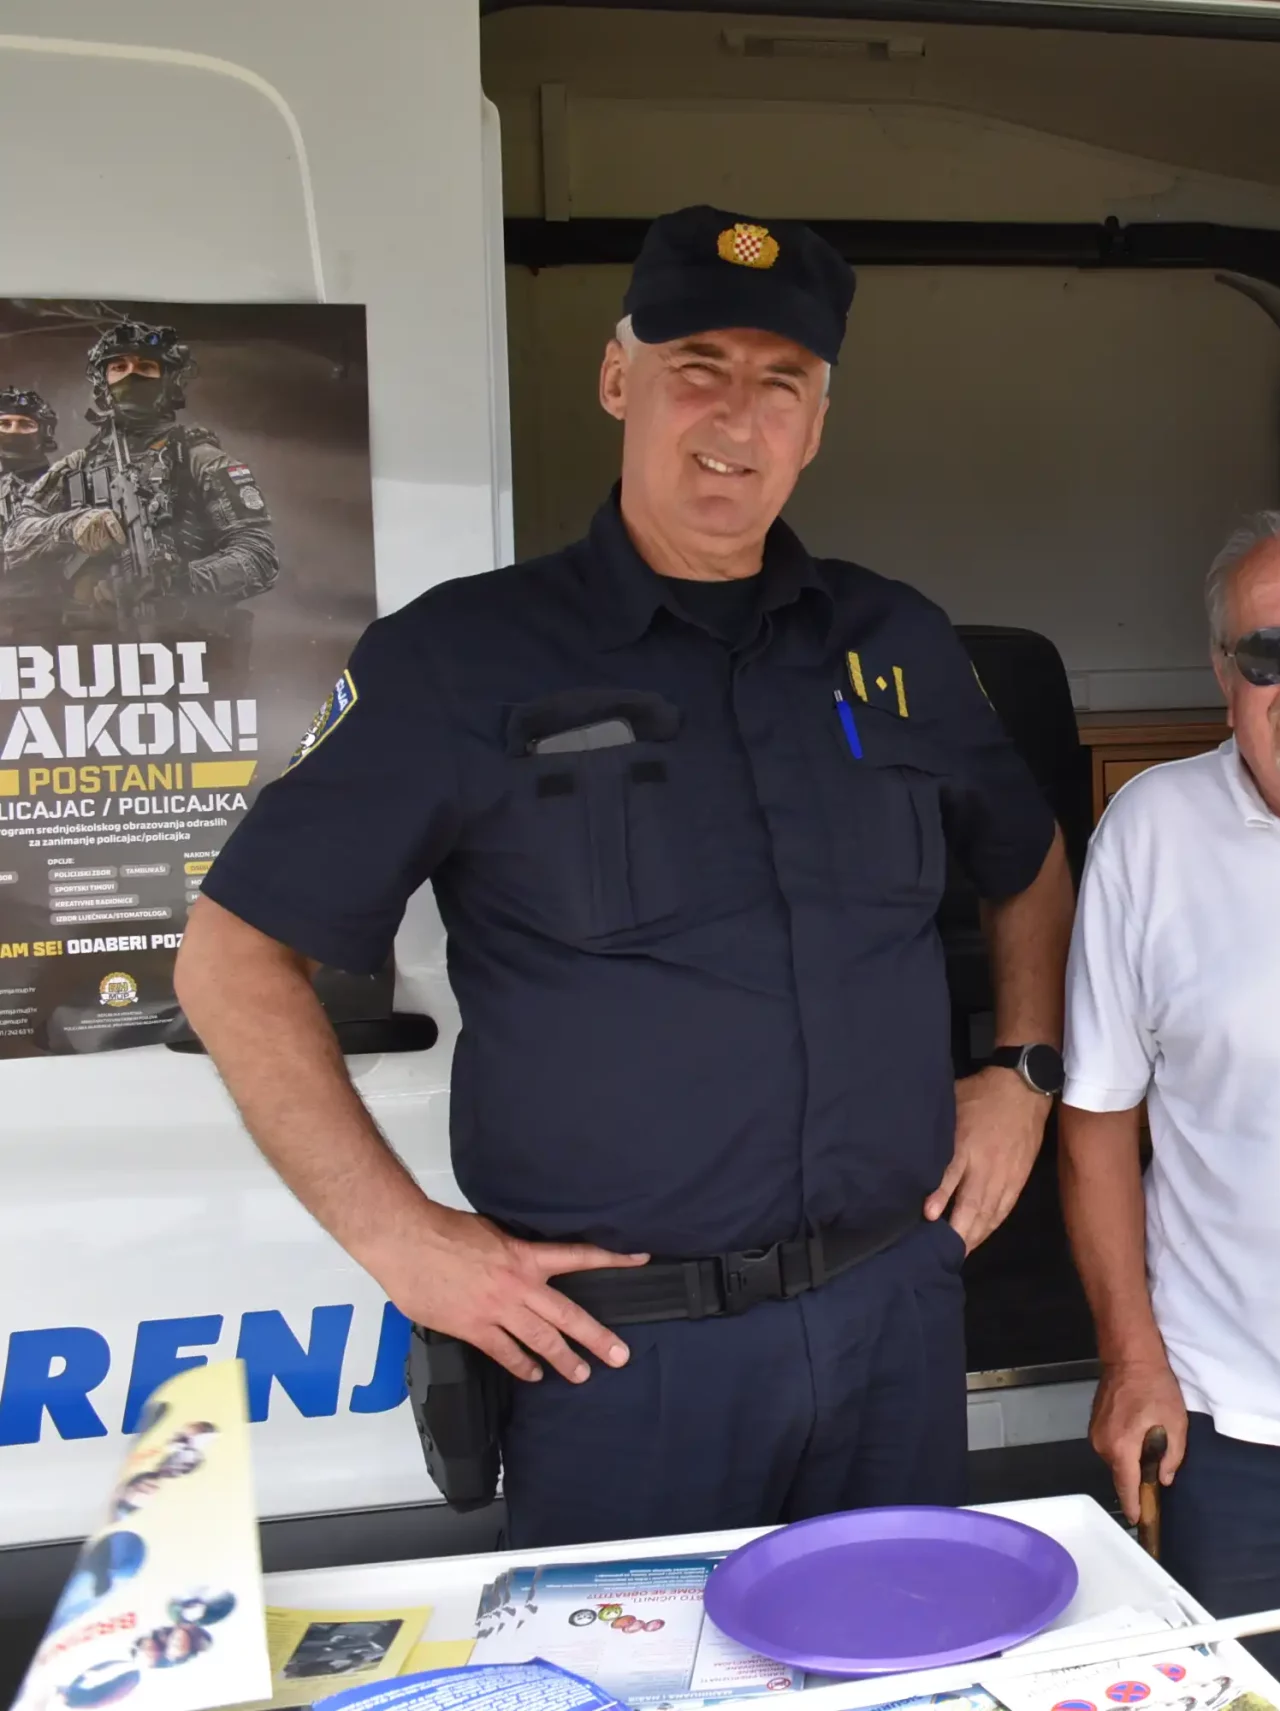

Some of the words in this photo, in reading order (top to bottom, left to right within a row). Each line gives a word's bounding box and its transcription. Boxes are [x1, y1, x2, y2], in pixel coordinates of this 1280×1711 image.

[0, 641, 209, 699] BUDI
[1, 699, 259, 760] AKON!
[28, 763, 183, 796] POSTANI
[119, 792, 249, 815] POLICAJKA
[0, 826, 35, 838] ogram
[36, 822, 121, 835] srednjoškolskog
[122, 819, 185, 831] obrazovanja
[186, 817, 228, 828] odraslih
[28, 839, 41, 847] za
[42, 835, 96, 847] zanimanje
[97, 831, 191, 845] policajac/policajka
[54, 884, 89, 893] SPORTSKI
[90, 883, 115, 891] TIMOVI
[55, 899, 95, 908] KREATIVNE
[95, 897, 133, 906] RADIONICE
[0, 943, 29, 959] AM
[33, 940, 63, 957] SE!
[67, 936, 147, 955] ODABERI
